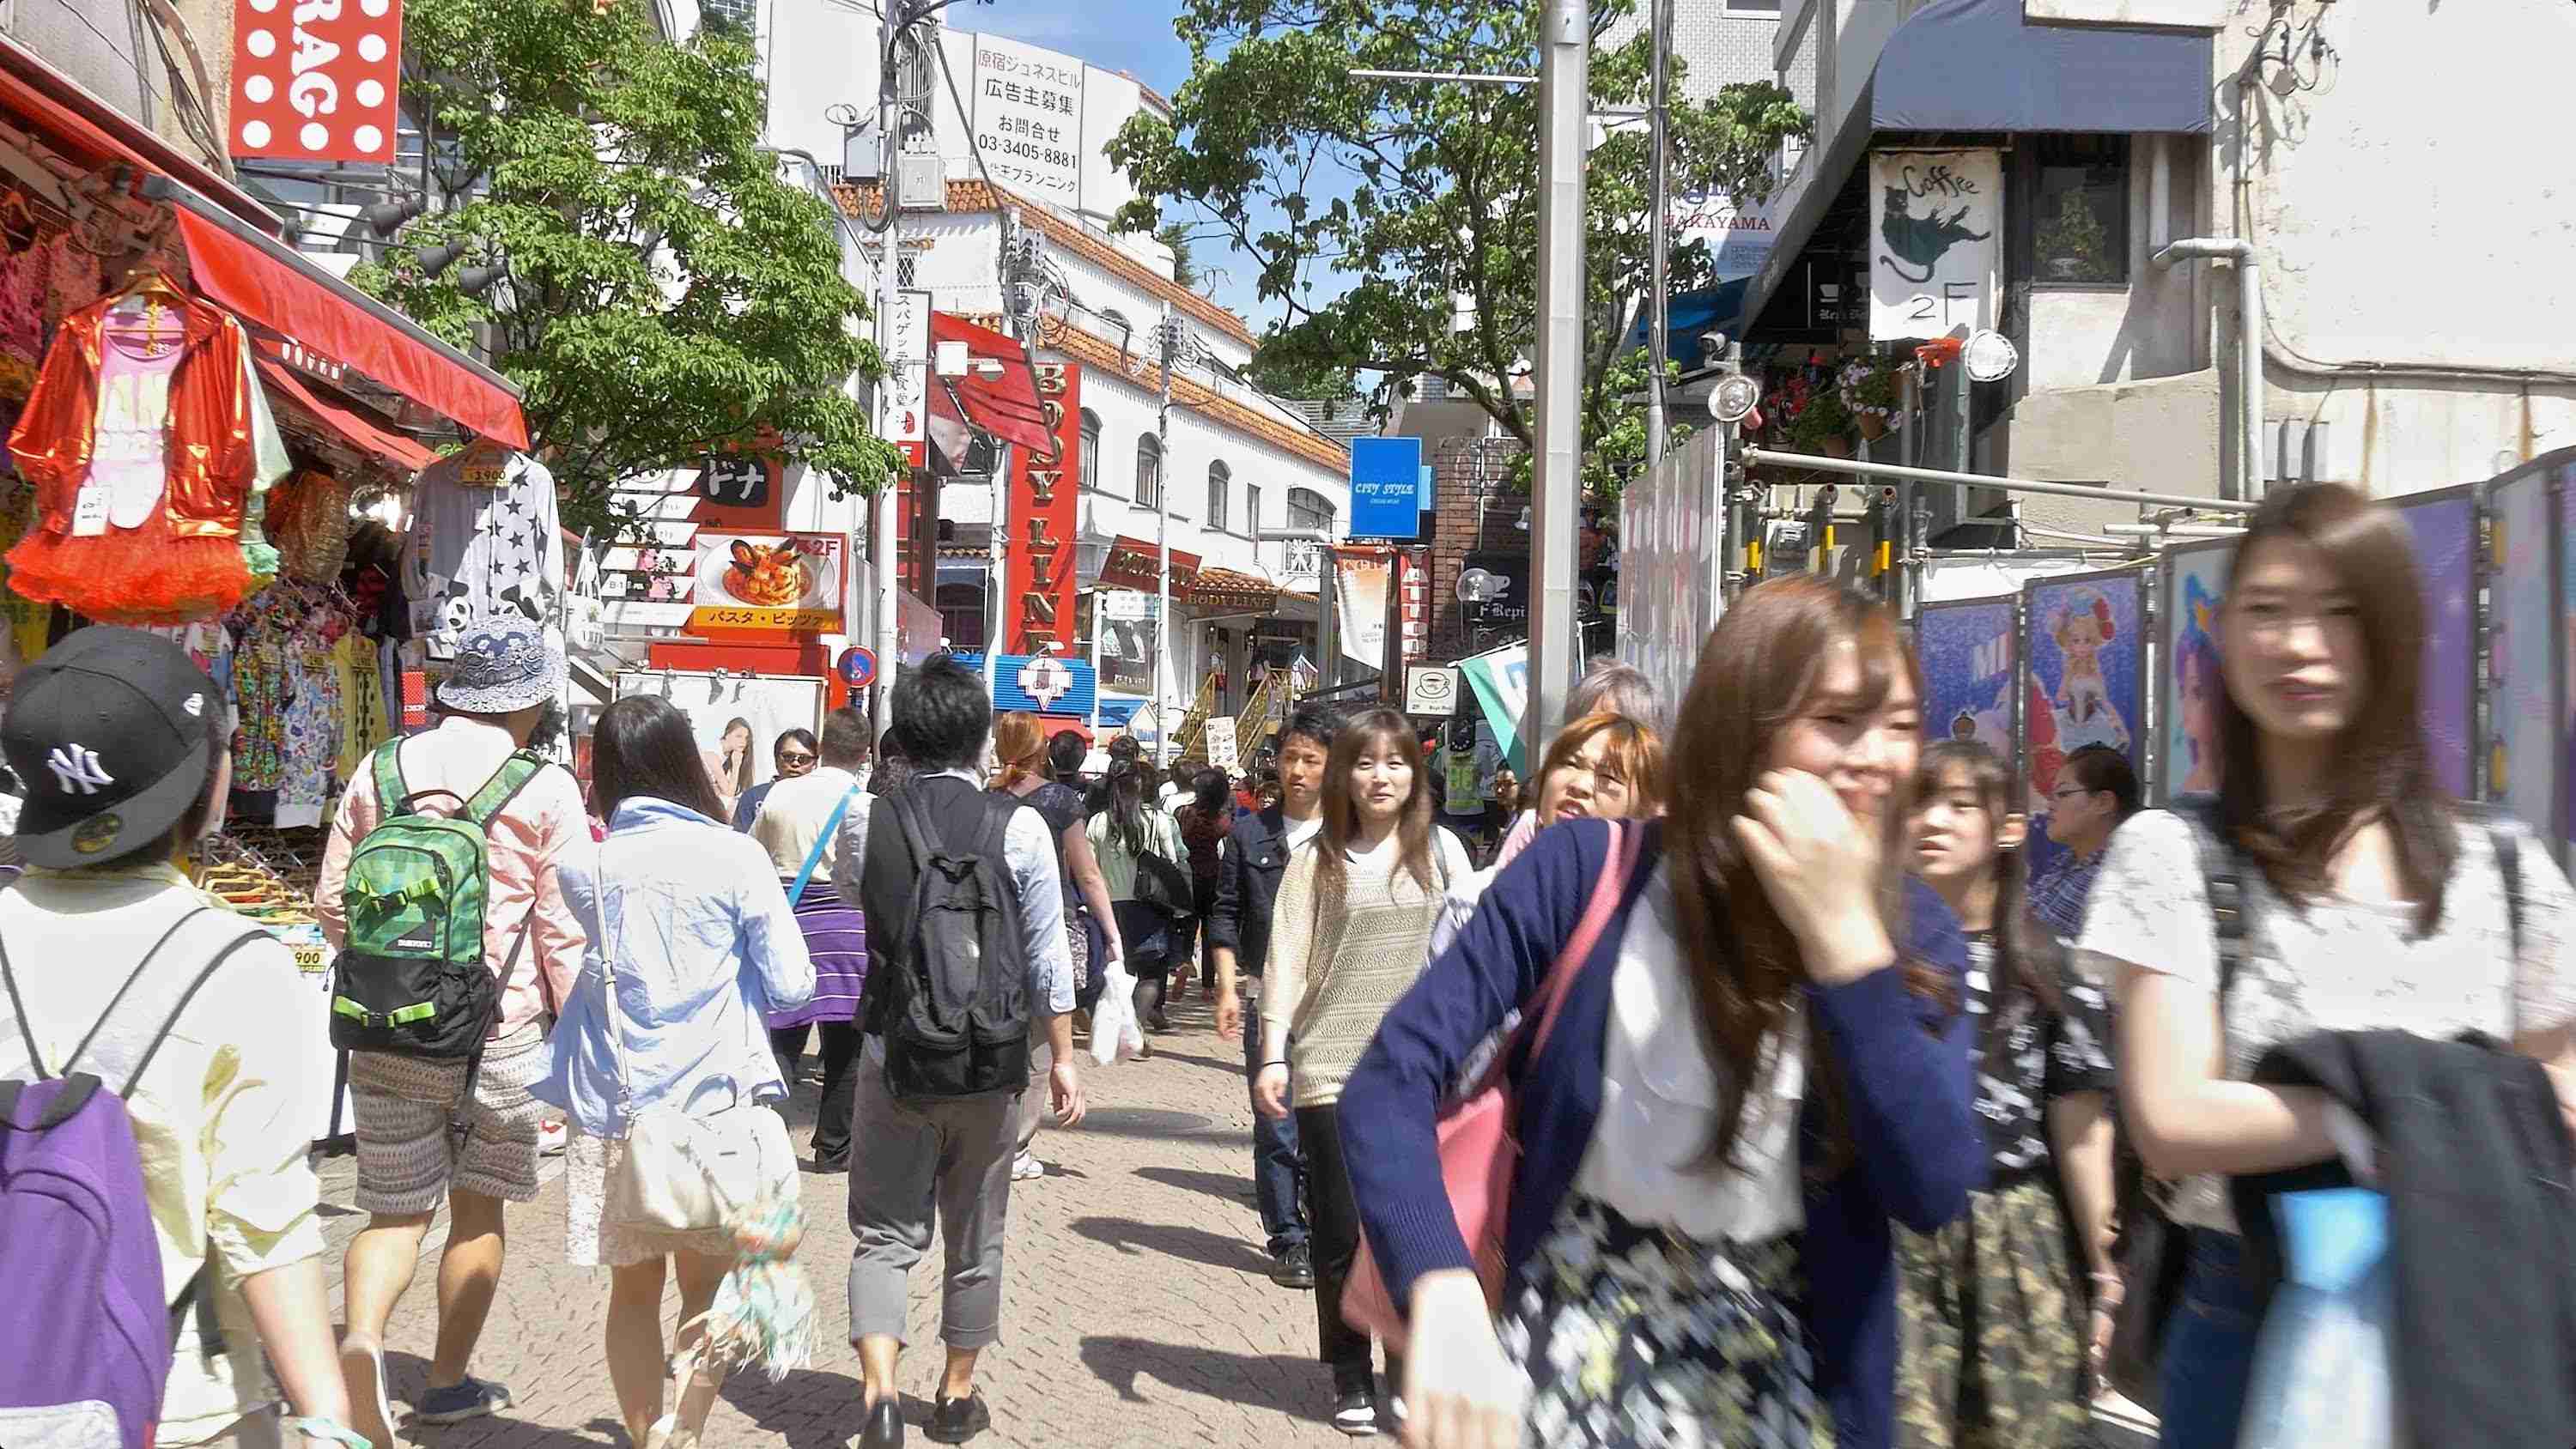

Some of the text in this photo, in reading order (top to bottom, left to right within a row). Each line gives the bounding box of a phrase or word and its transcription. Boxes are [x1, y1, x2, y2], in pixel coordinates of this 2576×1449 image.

[978, 49, 1080, 89] 原宿ジュネスビル
[985, 78, 1073, 117] 広告主募集
[999, 114, 1060, 143] お問合せ
[979, 134, 1076, 169] 03-3405-8881
[1903, 166, 1979, 197] Coffee
[1908, 282, 1978, 326] 2F
[1355, 482, 1415, 496] CITY STYLE
[811, 540, 838, 556] 2F
[1401, 566, 1430, 654] ATTOO
[48, 743, 115, 795] NY
